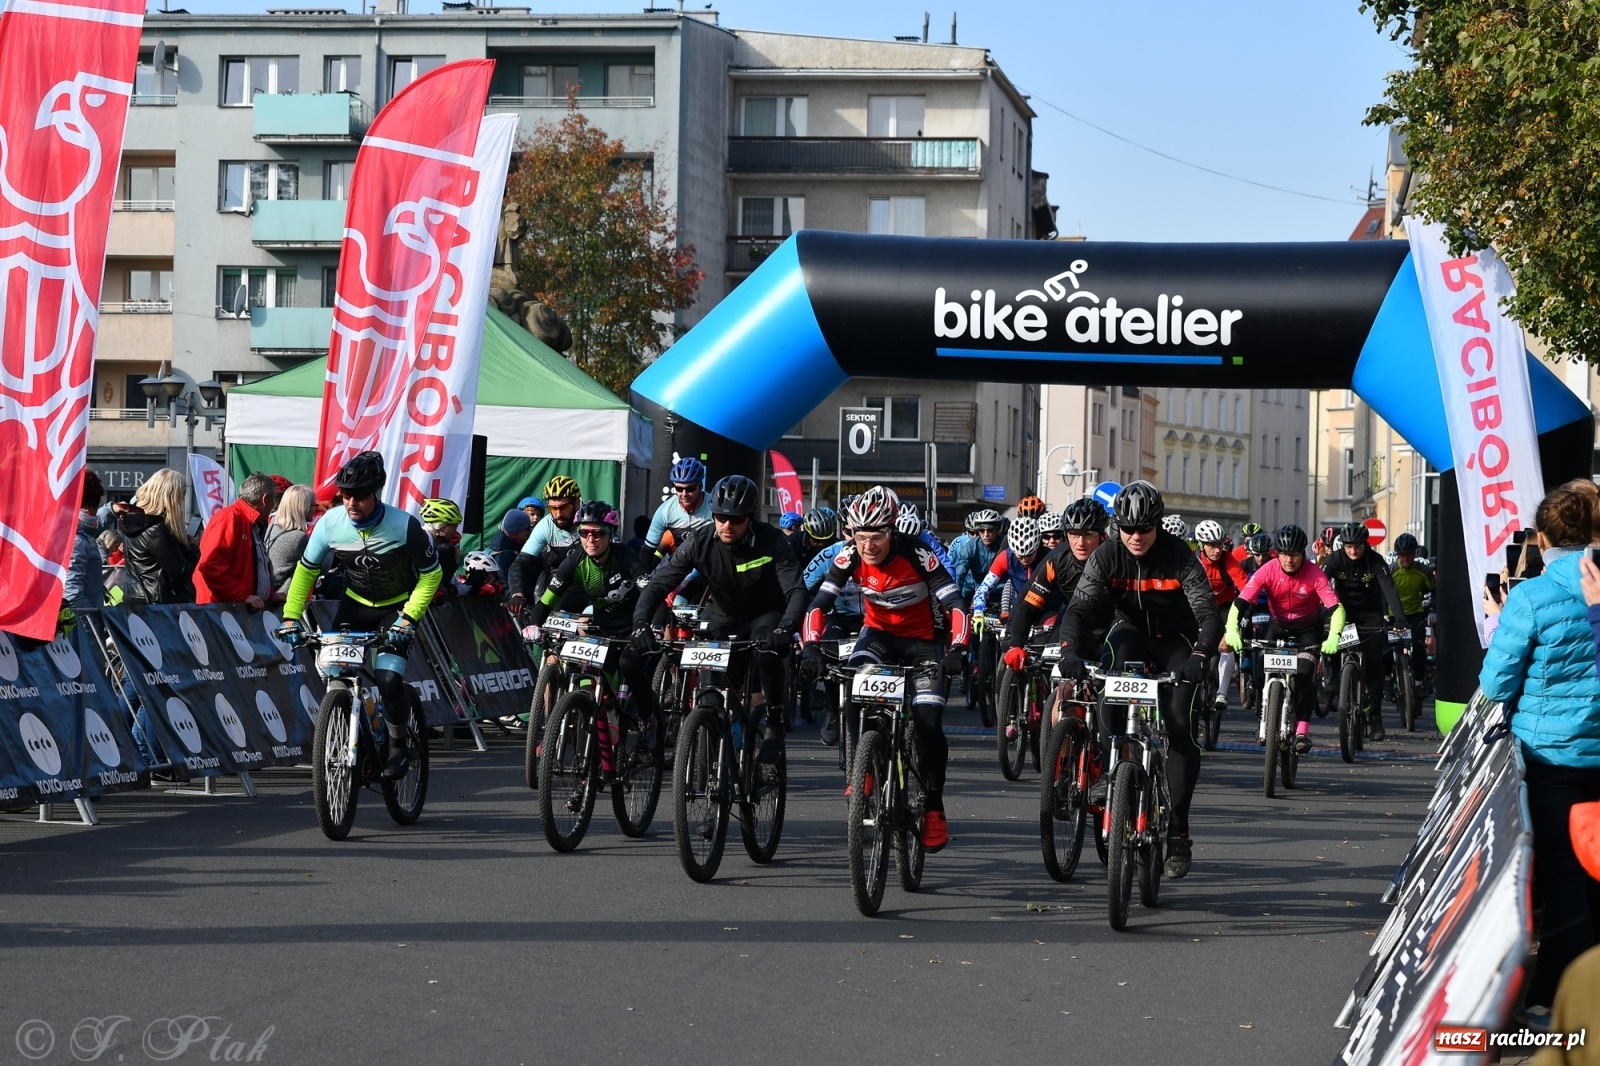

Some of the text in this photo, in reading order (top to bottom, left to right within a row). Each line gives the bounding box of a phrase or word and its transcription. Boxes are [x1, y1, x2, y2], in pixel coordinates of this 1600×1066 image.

[934, 287, 1243, 346] bike atelier
[846, 413, 876, 422] SEKTOR
[848, 423, 872, 455] 0
[548, 618, 572, 628] 1046
[1340, 632, 1354, 642] 896
[328, 646, 357, 658] 1146
[571, 645, 600, 659] 1564
[690, 651, 722, 662] 3068
[1270, 657, 1292, 667] 1018
[470, 668, 534, 695] MERIDA
[862, 680, 897, 693] 1630
[1113, 681, 1148, 693] 2882
[98, 769, 139, 787] KOKOwear
[36, 778, 84, 795] KOKOwear
